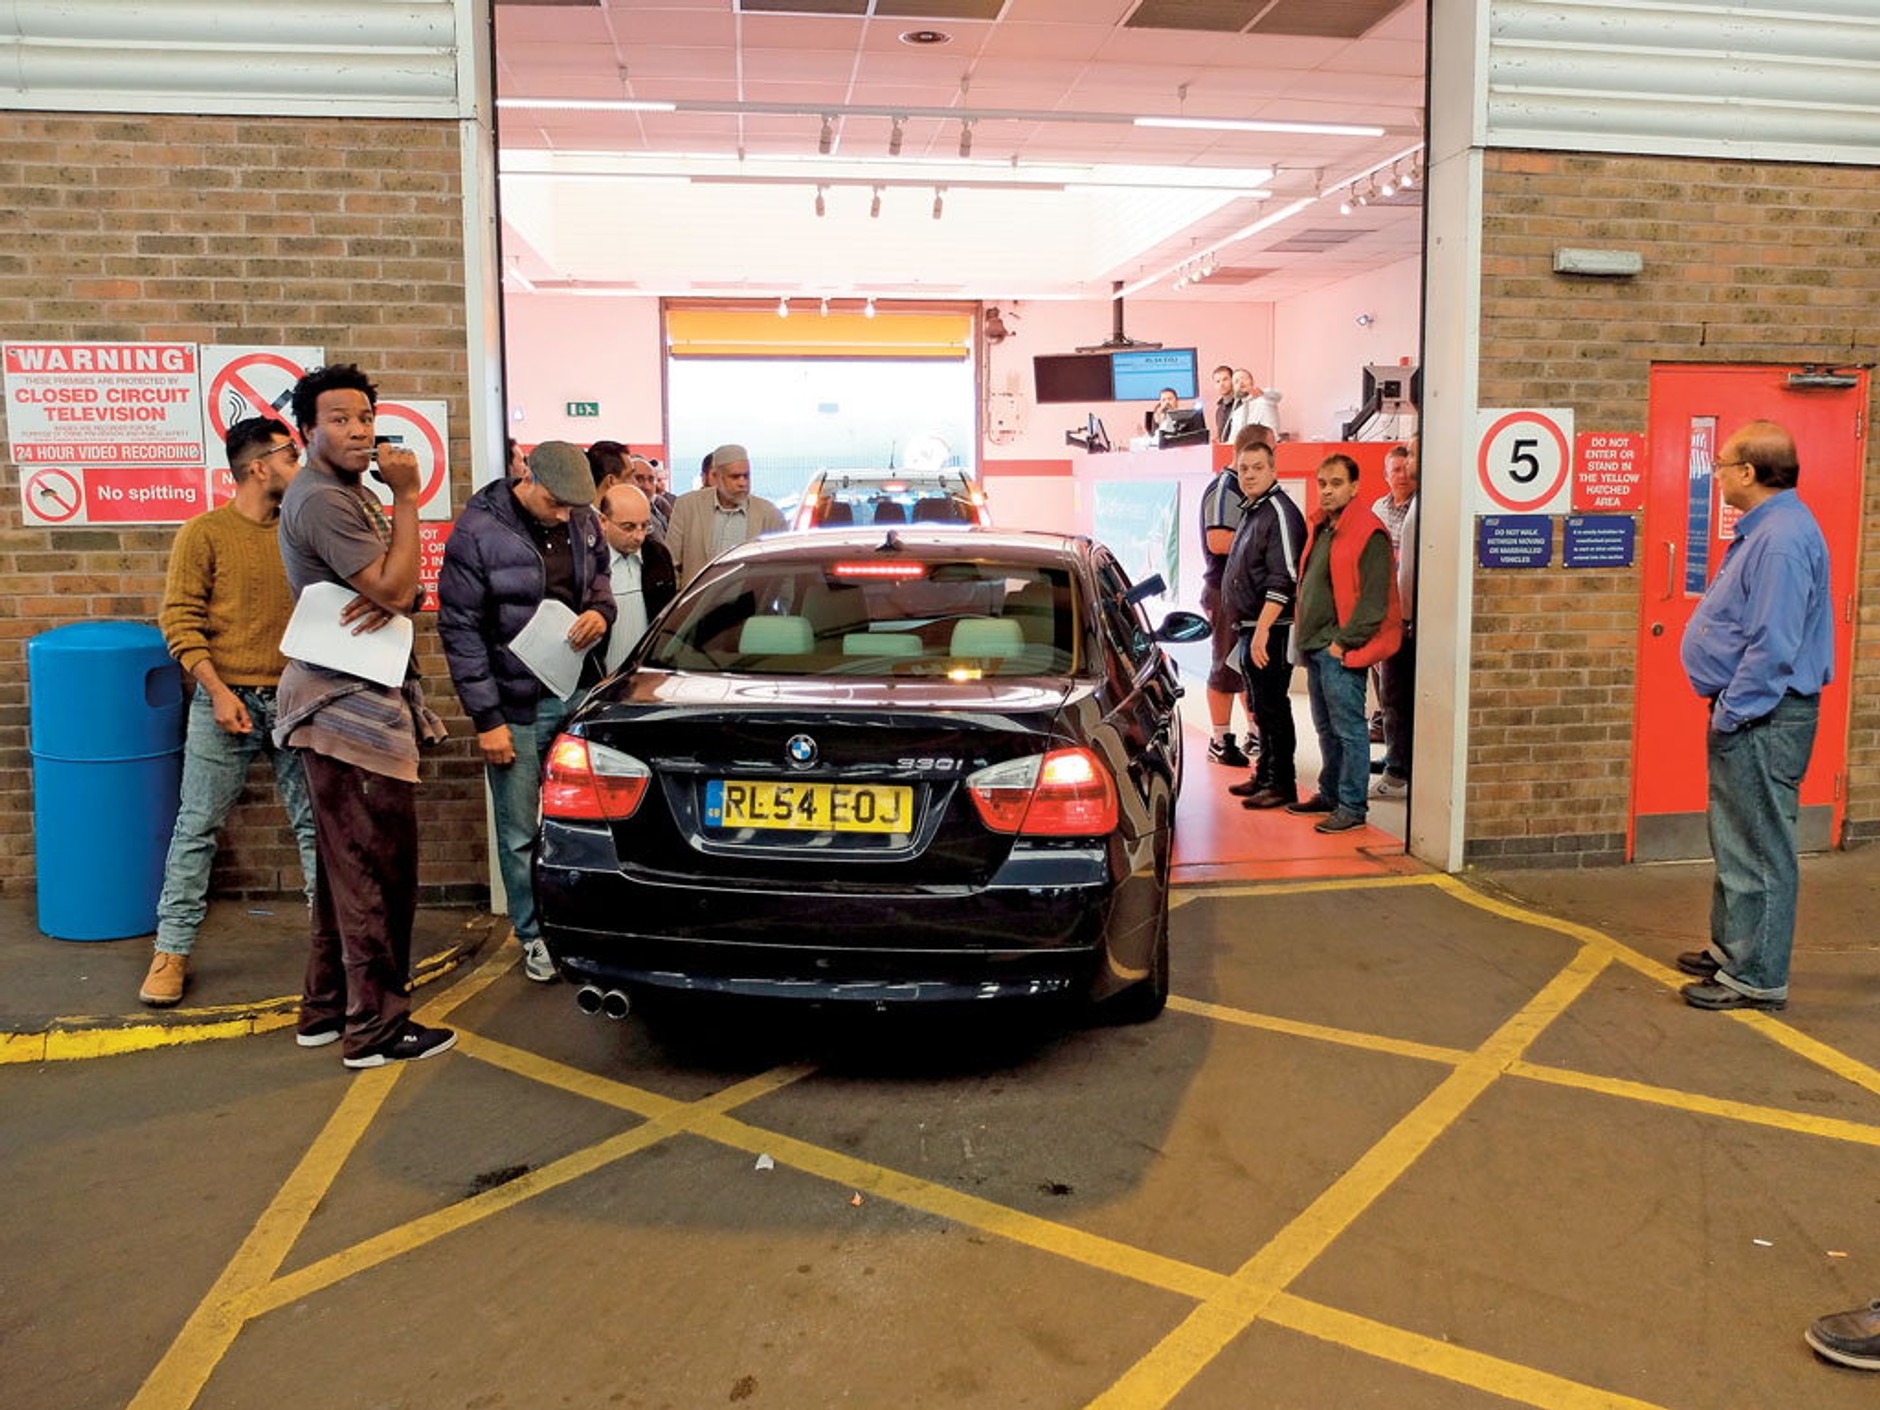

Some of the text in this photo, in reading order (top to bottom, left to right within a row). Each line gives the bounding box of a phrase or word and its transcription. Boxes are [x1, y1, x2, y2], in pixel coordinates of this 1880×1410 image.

[16, 348, 185, 370] WARNING
[15, 388, 190, 403] CLOSED CIRCUIT
[43, 406, 166, 421] TELEVISION
[1591, 437, 1629, 447] DO NOT
[16, 444, 200, 460] 24 HOUR VIDEO RECORDING
[1585, 449, 1635, 459] ENTER OR
[1508, 439, 1540, 484] 5
[1588, 461, 1632, 471] STAND IN
[1579, 473, 1640, 483] THE YELLOW
[97, 485, 196, 502] No spitting
[1586, 485, 1630, 495] HATCHED
[1594, 496, 1621, 506] AREA
[428, 543, 446, 553] OR
[431, 556, 444, 566] IN
[724, 786, 900, 824] RL54 EOJ
